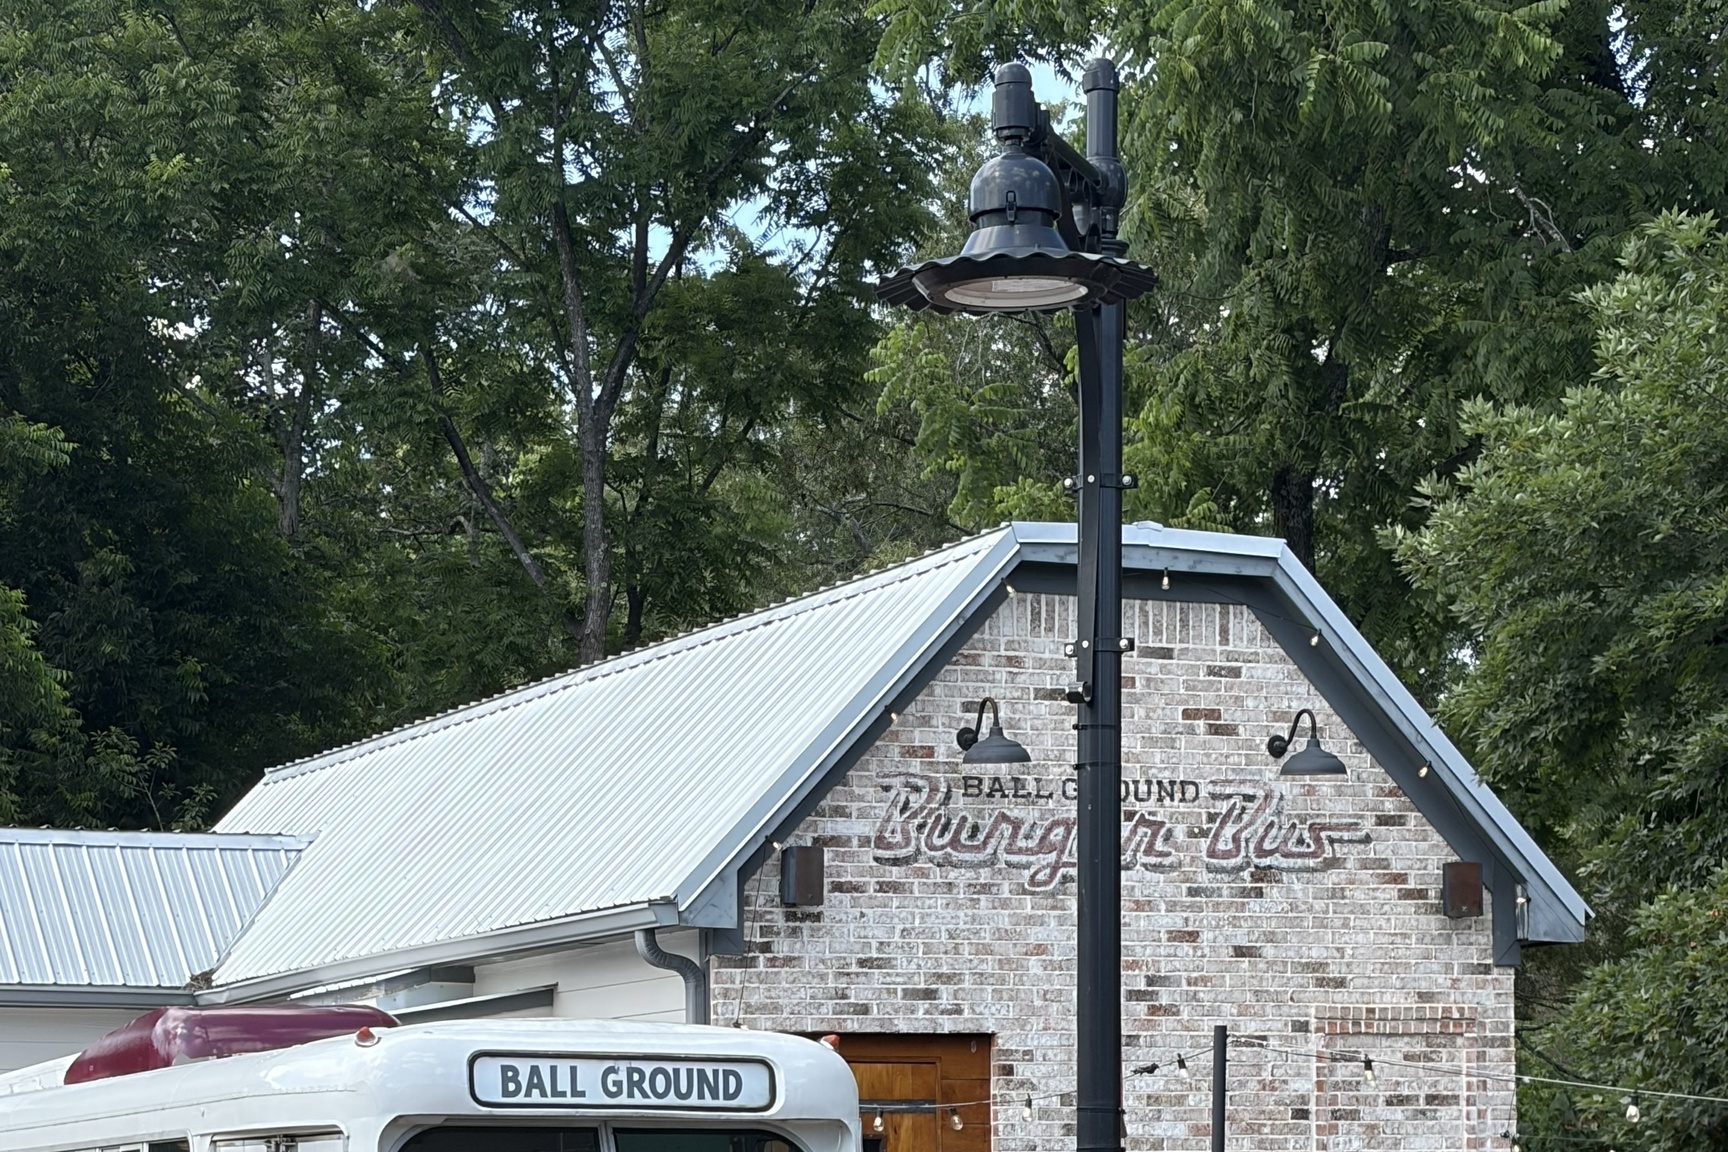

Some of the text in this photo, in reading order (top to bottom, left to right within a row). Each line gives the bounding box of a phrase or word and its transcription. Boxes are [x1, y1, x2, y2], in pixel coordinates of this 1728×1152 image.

[962, 776, 1200, 803] BALL GOUND
[873, 772, 1369, 891] Burgr Bus
[500, 1064, 743, 1101] BALL GROUND
